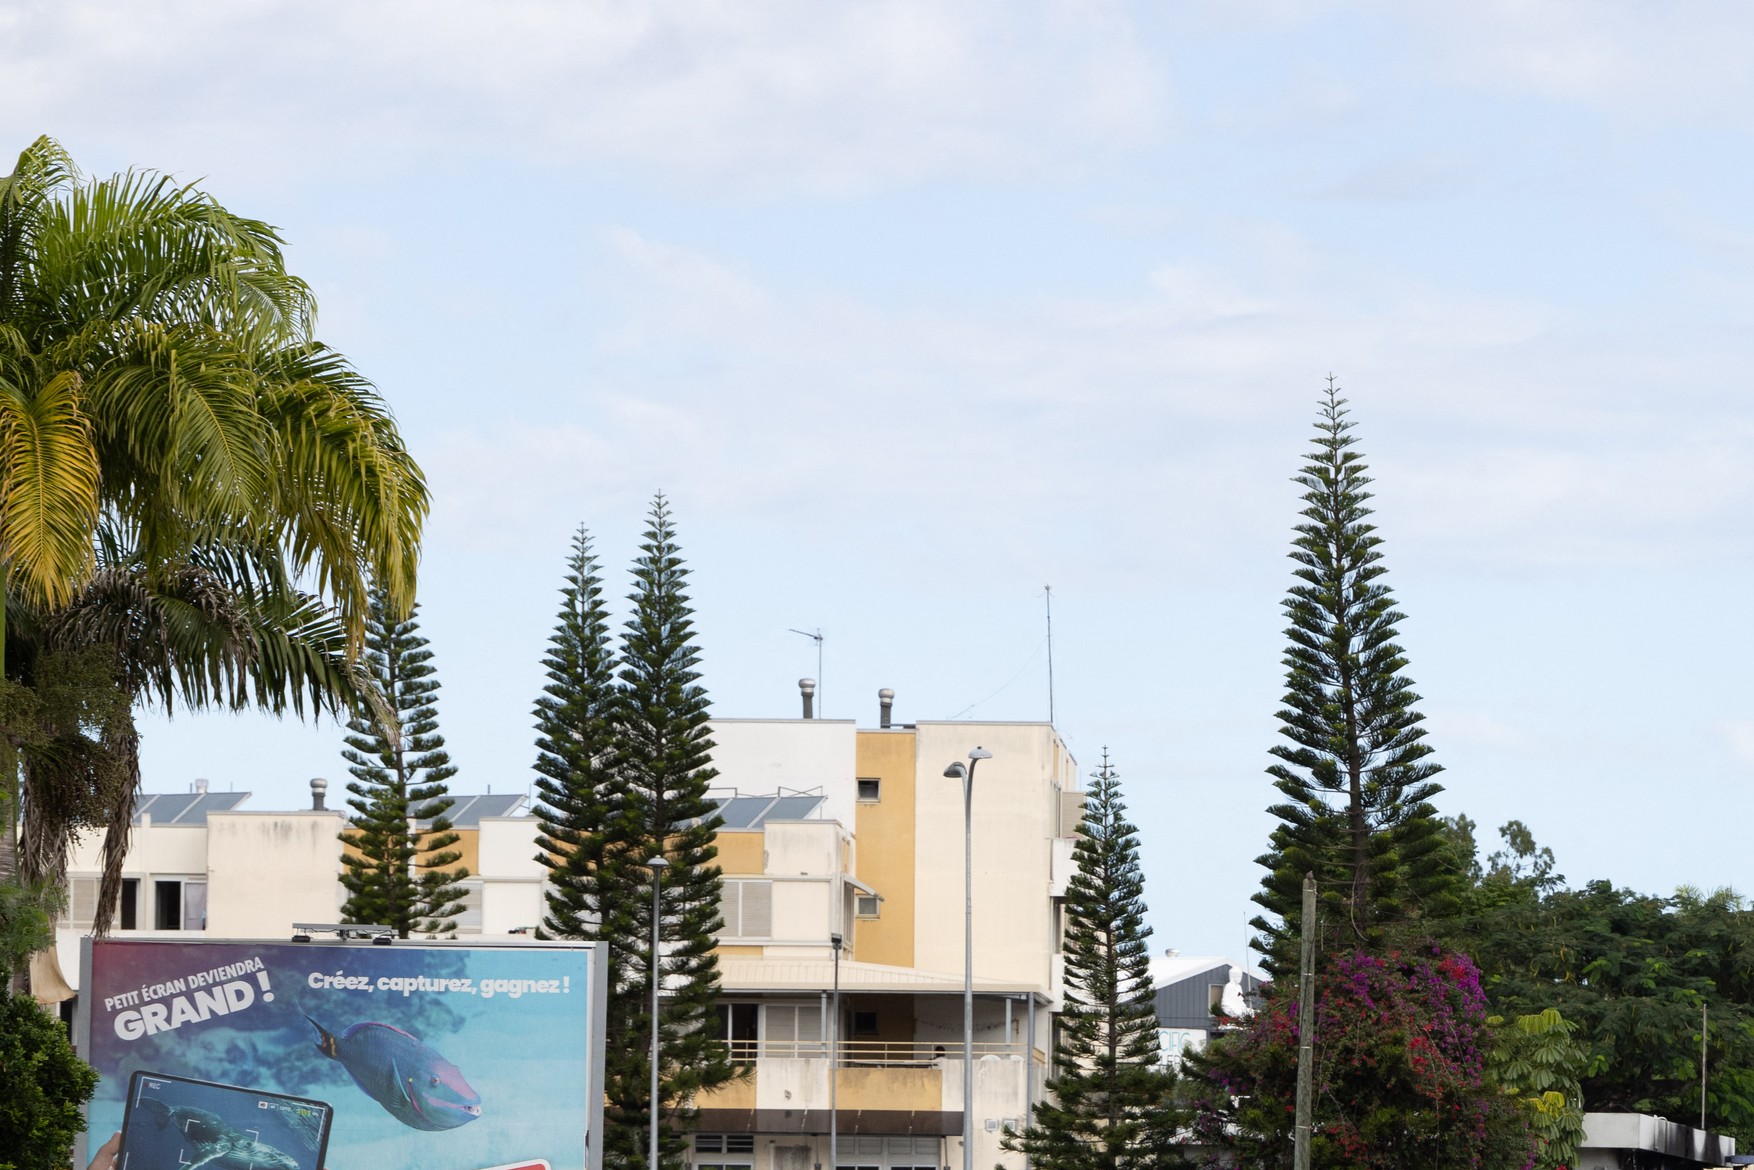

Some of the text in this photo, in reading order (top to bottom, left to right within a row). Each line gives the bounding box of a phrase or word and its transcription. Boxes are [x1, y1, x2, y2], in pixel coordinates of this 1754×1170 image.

[104, 956, 264, 1011] PETIT ÉCRAN DEVIENDRA
[114, 980, 255, 1041] GRAND
[307, 970, 375, 992] Créez,
[377, 975, 477, 997] capturez,
[480, 977, 560, 999] gagnez
